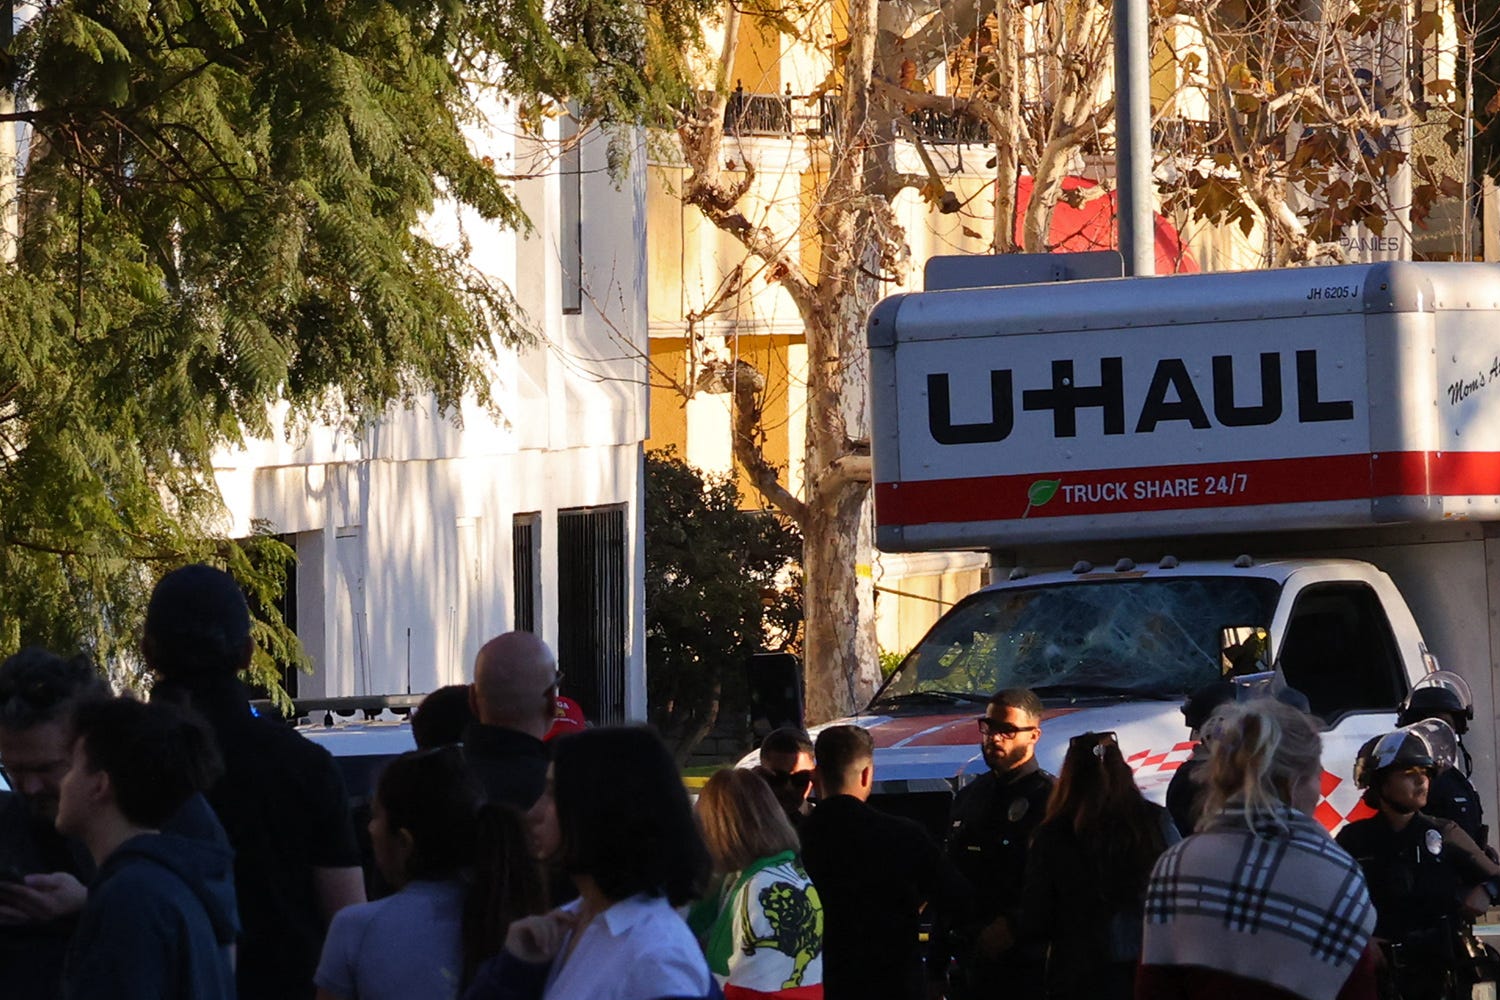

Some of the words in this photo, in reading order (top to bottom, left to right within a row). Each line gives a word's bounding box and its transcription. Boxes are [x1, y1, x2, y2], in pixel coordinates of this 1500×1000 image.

[1339, 236, 1399, 251] PANIES
[1307, 287, 1322, 300] JH
[1324, 286, 1350, 299] 6205
[1351, 286, 1359, 298] J
[1448, 371, 1486, 405] Mom's
[1062, 480, 1128, 505] TRUCK
[1134, 476, 1198, 501] SHARE
[1205, 472, 1250, 497] 24/7
